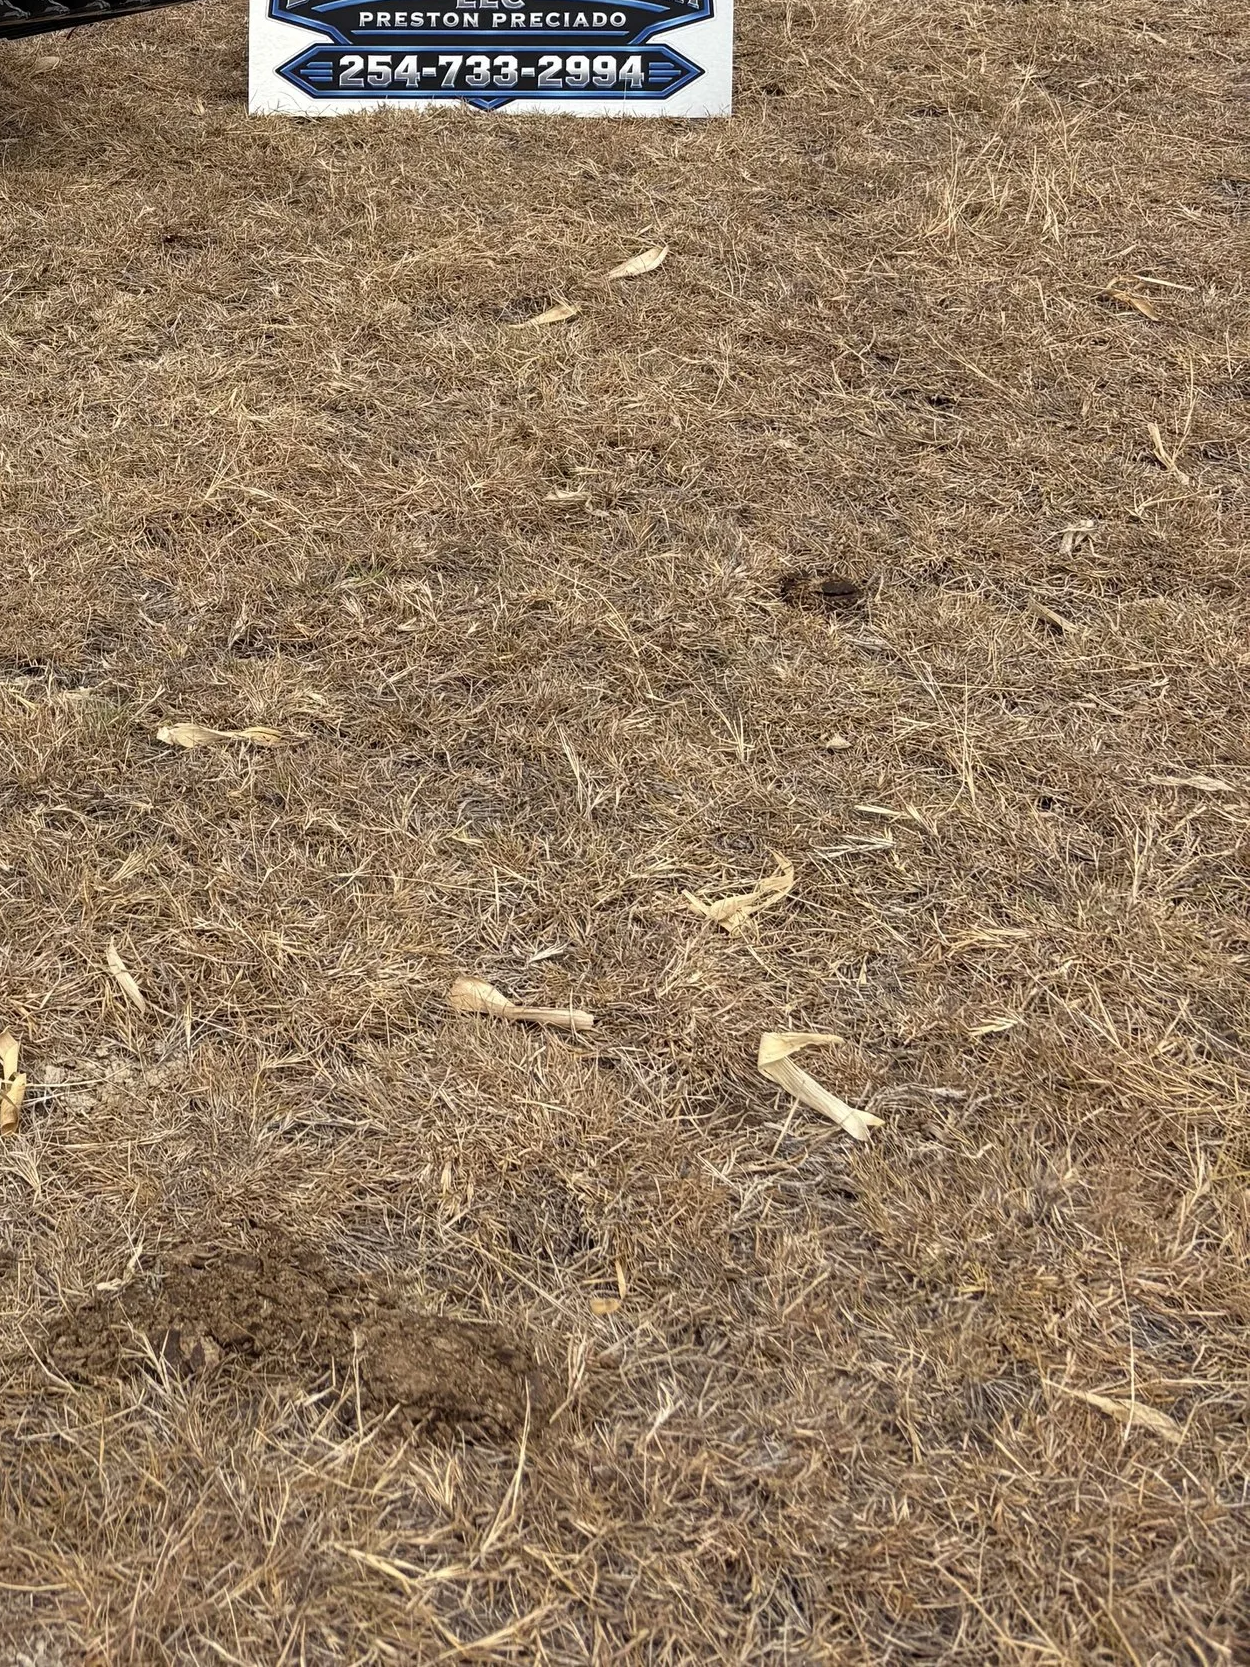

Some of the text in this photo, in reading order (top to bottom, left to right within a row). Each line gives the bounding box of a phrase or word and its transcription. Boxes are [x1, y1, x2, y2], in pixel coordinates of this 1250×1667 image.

[358, 11, 628, 29] PRESTON PRECIADO
[339, 54, 646, 89] 254-733-2994
